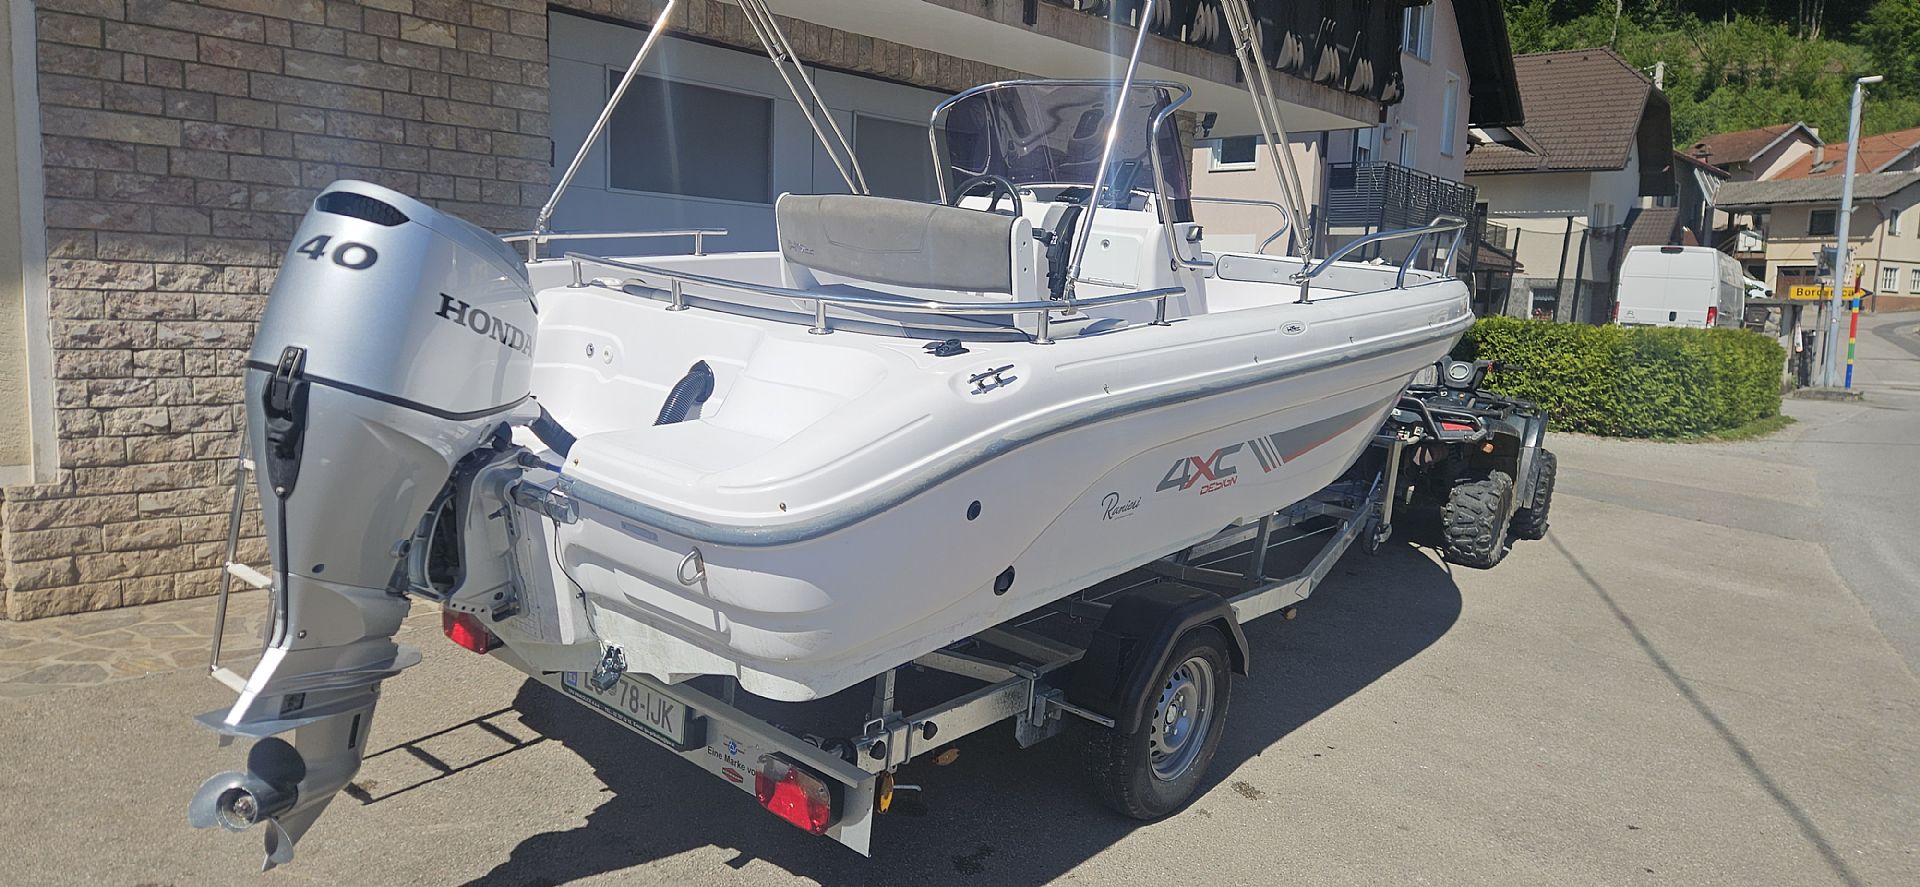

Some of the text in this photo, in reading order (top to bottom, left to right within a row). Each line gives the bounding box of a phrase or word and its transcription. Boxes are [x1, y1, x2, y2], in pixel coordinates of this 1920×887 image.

[296, 234, 378, 270] 40
[1796, 287, 1855, 297] Boroca
[434, 292, 533, 358] HONDA
[1155, 442, 1245, 492] 4XC
[1199, 475, 1238, 495] DESIGN
[584, 671, 603, 695] L
[619, 679, 673, 733] 78-IJK
[707, 745, 723, 760] Eine
[724, 754, 746, 771] Marke
[747, 766, 756, 776] vo
